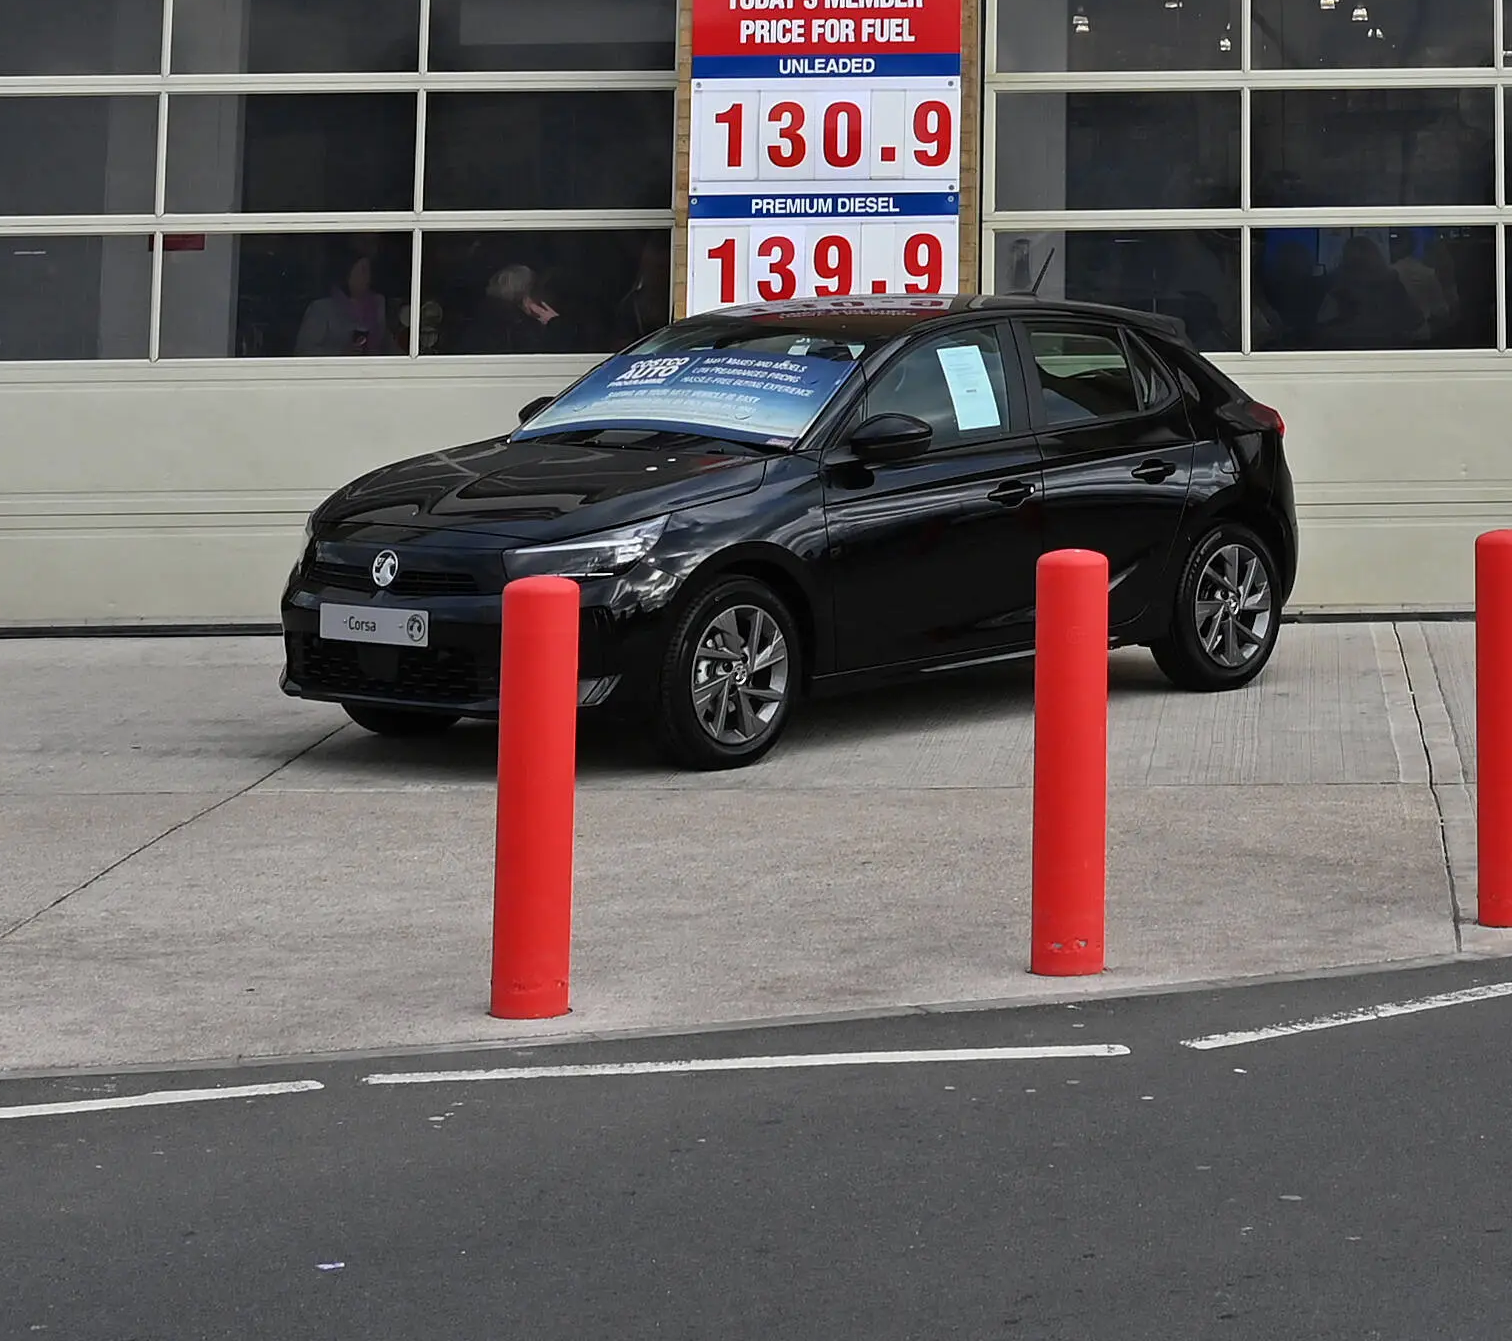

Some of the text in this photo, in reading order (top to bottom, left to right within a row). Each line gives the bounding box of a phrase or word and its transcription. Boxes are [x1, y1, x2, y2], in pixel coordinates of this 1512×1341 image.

[740, 19, 915, 44] PRICE FOR FUEL
[779, 58, 875, 74] UNLEADED
[715, 100, 952, 168] 130.9
[751, 197, 899, 214] PREMIUM DIESEL
[707, 233, 943, 303] 139.9
[631, 357, 689, 369] COSTCO
[616, 365, 679, 381] AUTO
[348, 616, 376, 632] Corsa
